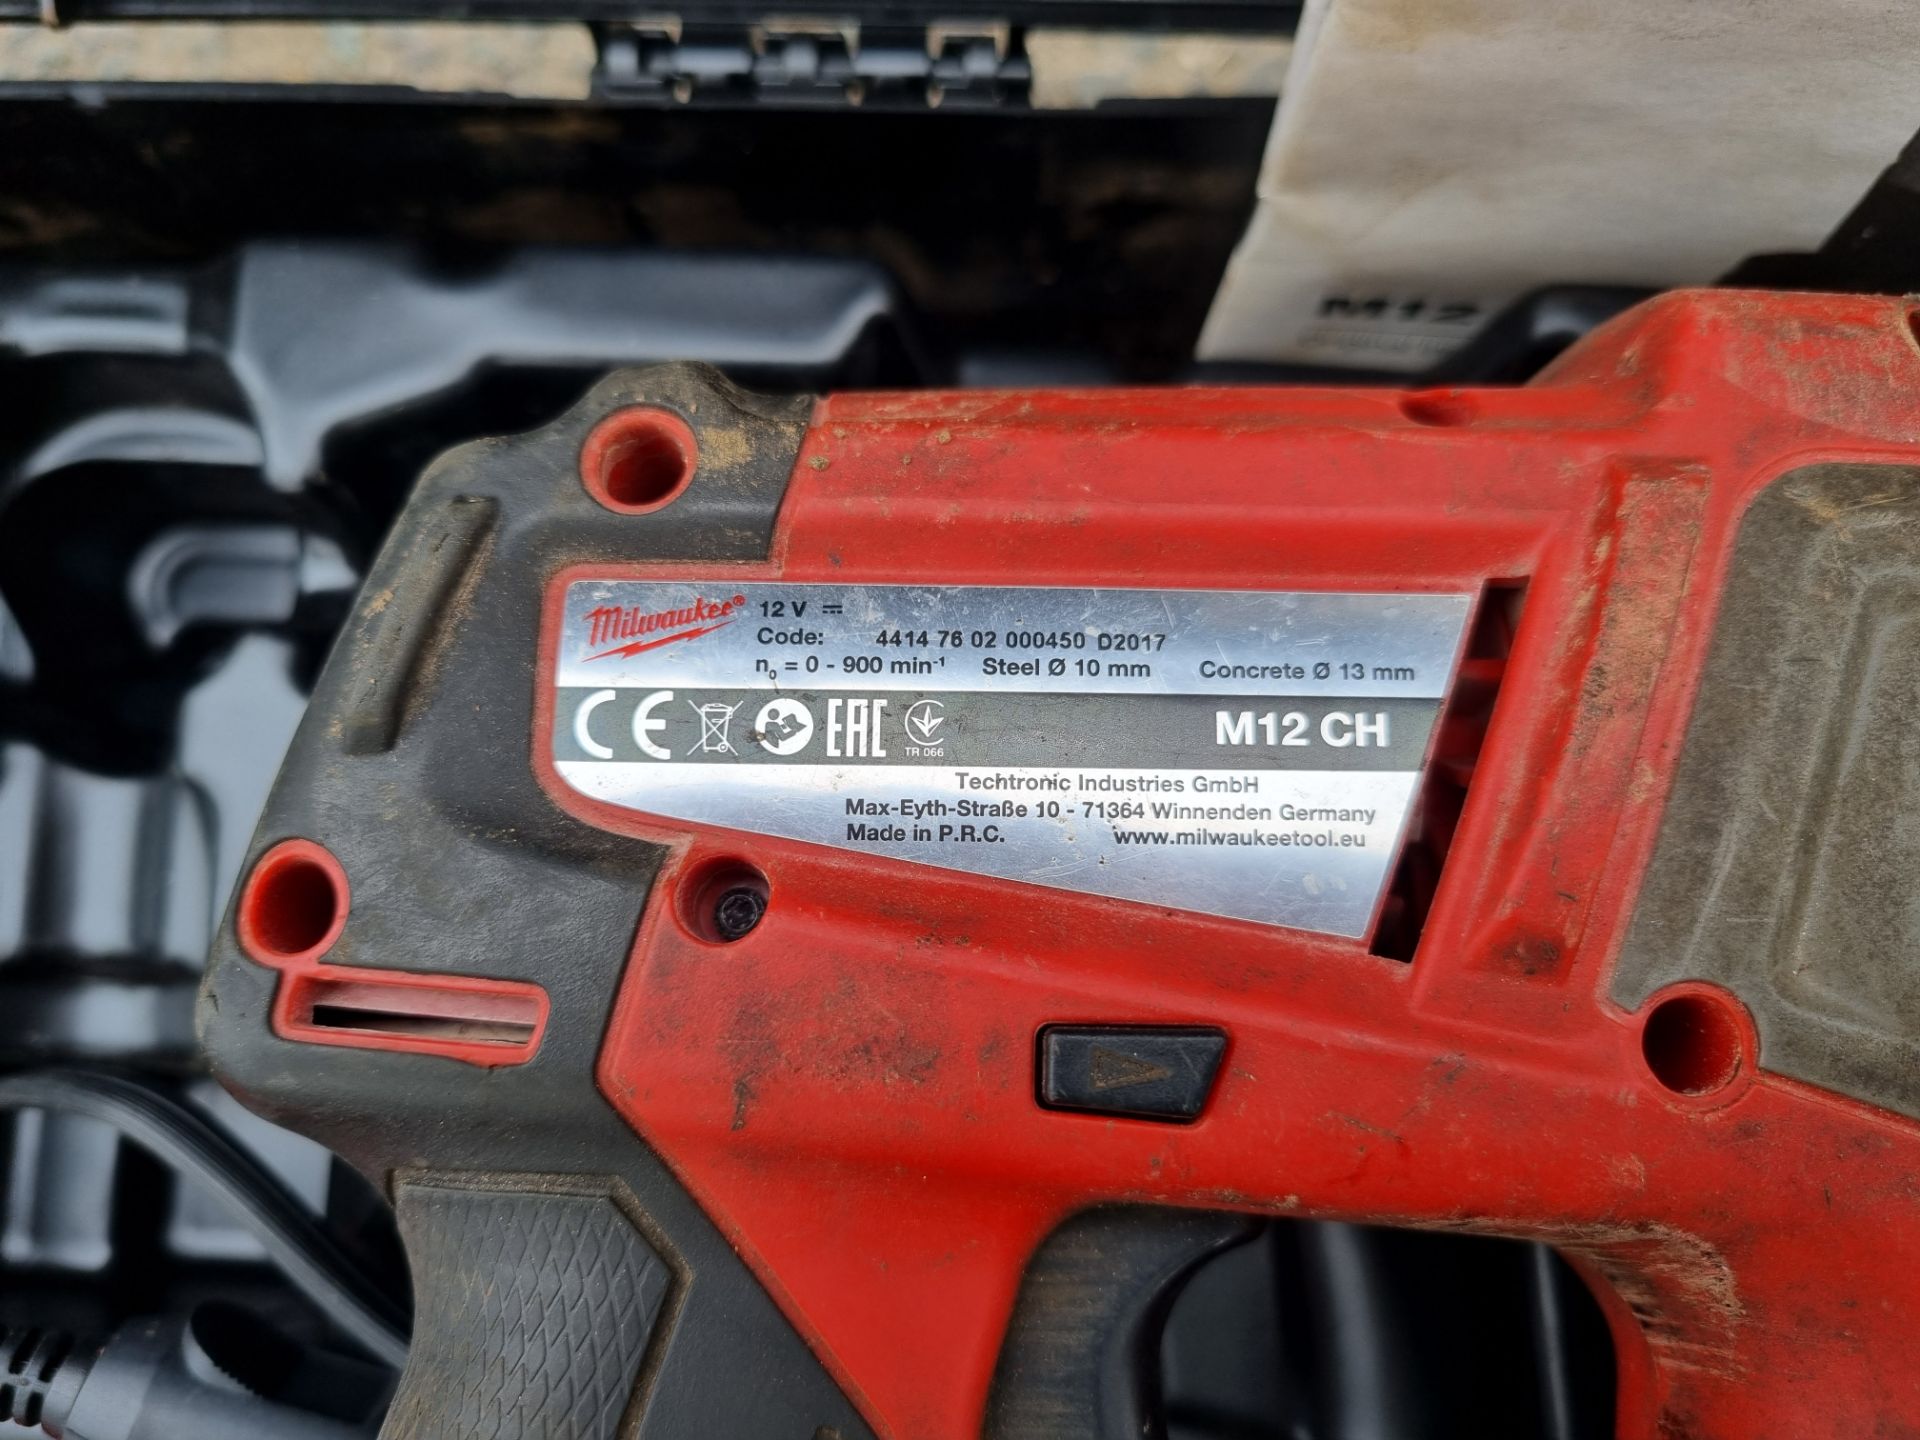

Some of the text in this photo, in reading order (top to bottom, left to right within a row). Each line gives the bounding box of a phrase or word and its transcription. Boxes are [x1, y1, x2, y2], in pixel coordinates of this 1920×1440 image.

[760, 601, 807, 617] 12 V
[757, 627, 1166, 651] Code: 4414 76 02 000450 D2017
[806, 655, 819, 673] 0
[843, 656, 883, 674] 900
[982, 657, 1040, 676] Steel
[1075, 659, 1100, 677] 10
[1108, 662, 1151, 677] mm
[1199, 660, 1305, 679] Concrete
[1339, 663, 1365, 680] 13
[1372, 666, 1415, 681] mm
[573, 689, 674, 760] CE
[1215, 710, 1392, 748] M12 CH
[905, 747, 944, 757] TR 066
[955, 771, 1259, 793] Techtronic Industries GmbH
[845, 798, 1028, 820] Max-Eyth-Straße
[1036, 801, 1060, 818] 10
[1082, 801, 1145, 819] 71364
[1151, 802, 1272, 820] Winnenden
[1278, 804, 1377, 825] Germany
[846, 823, 1005, 843] Made in P.R.C.
[1113, 828, 1366, 848] www.milwaukeetool.eu
